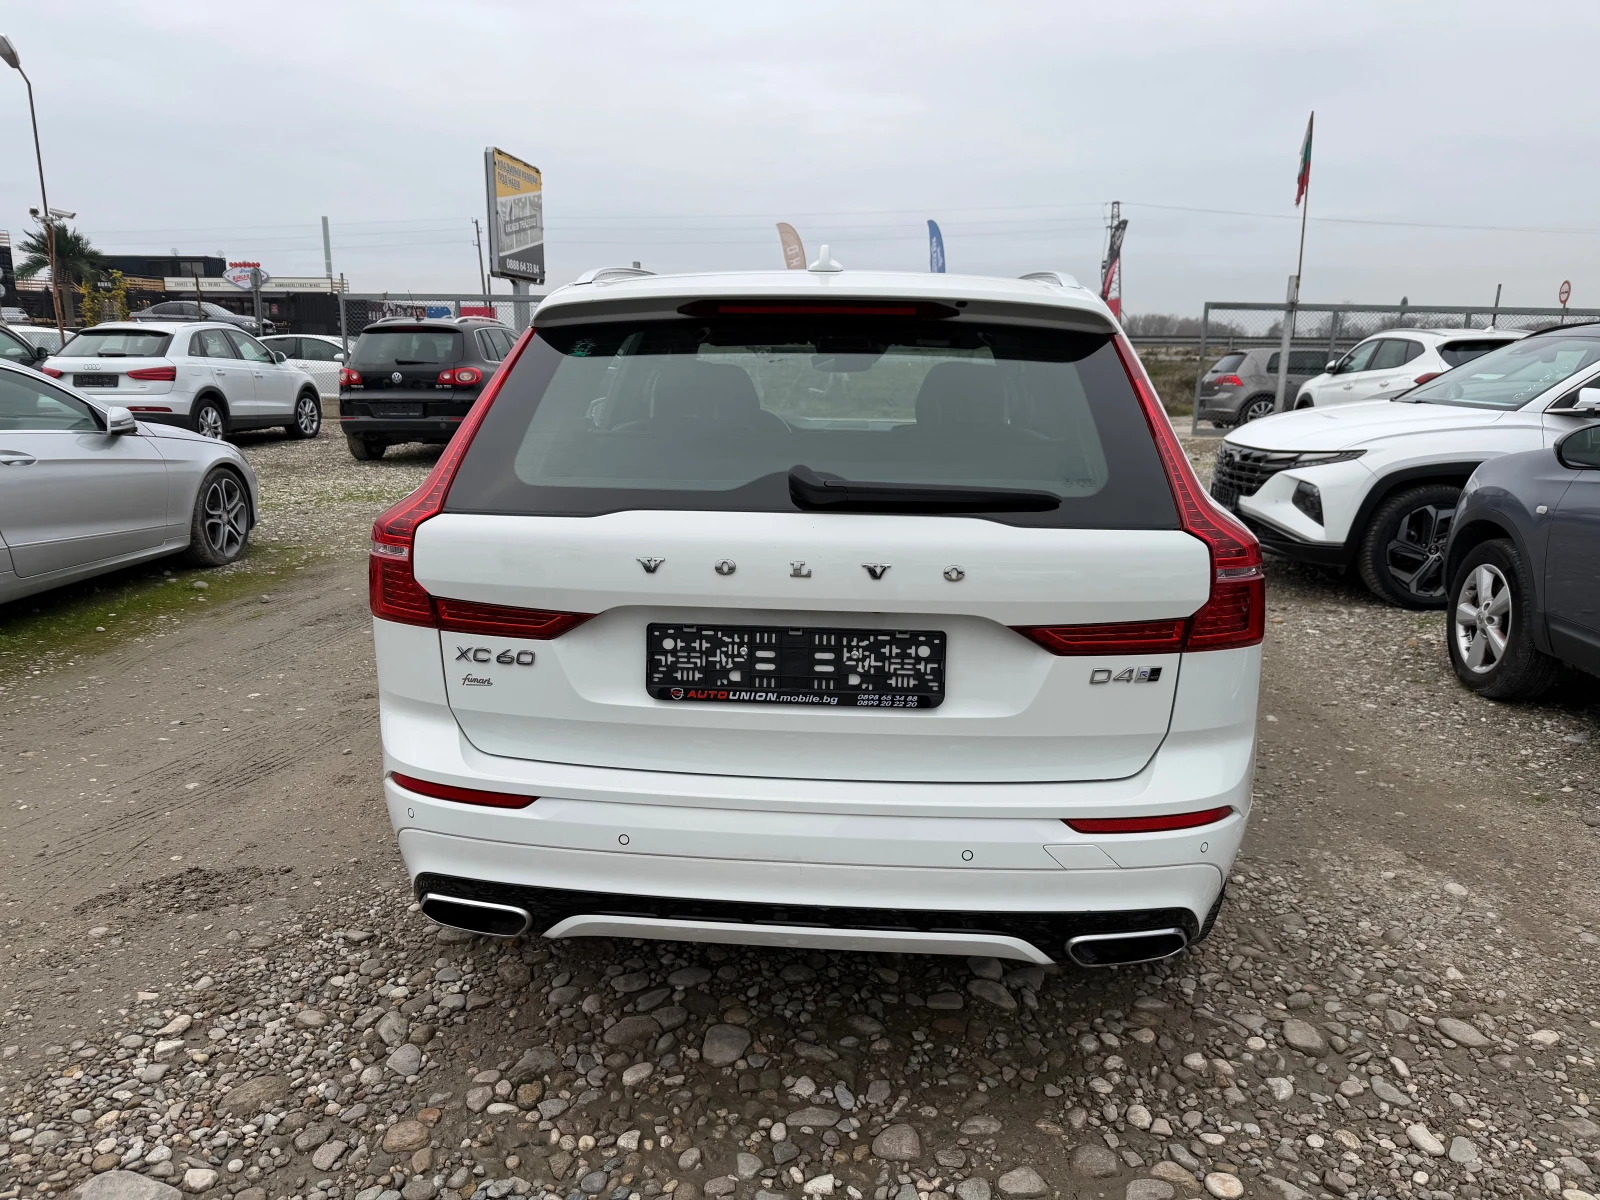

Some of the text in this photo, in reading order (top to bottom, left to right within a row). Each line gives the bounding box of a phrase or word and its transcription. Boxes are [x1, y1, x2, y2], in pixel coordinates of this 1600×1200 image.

[506, 258, 540, 274] 0888 64 33 84
[636, 556, 966, 583] VOLVO
[1089, 667, 1135, 685] D4
